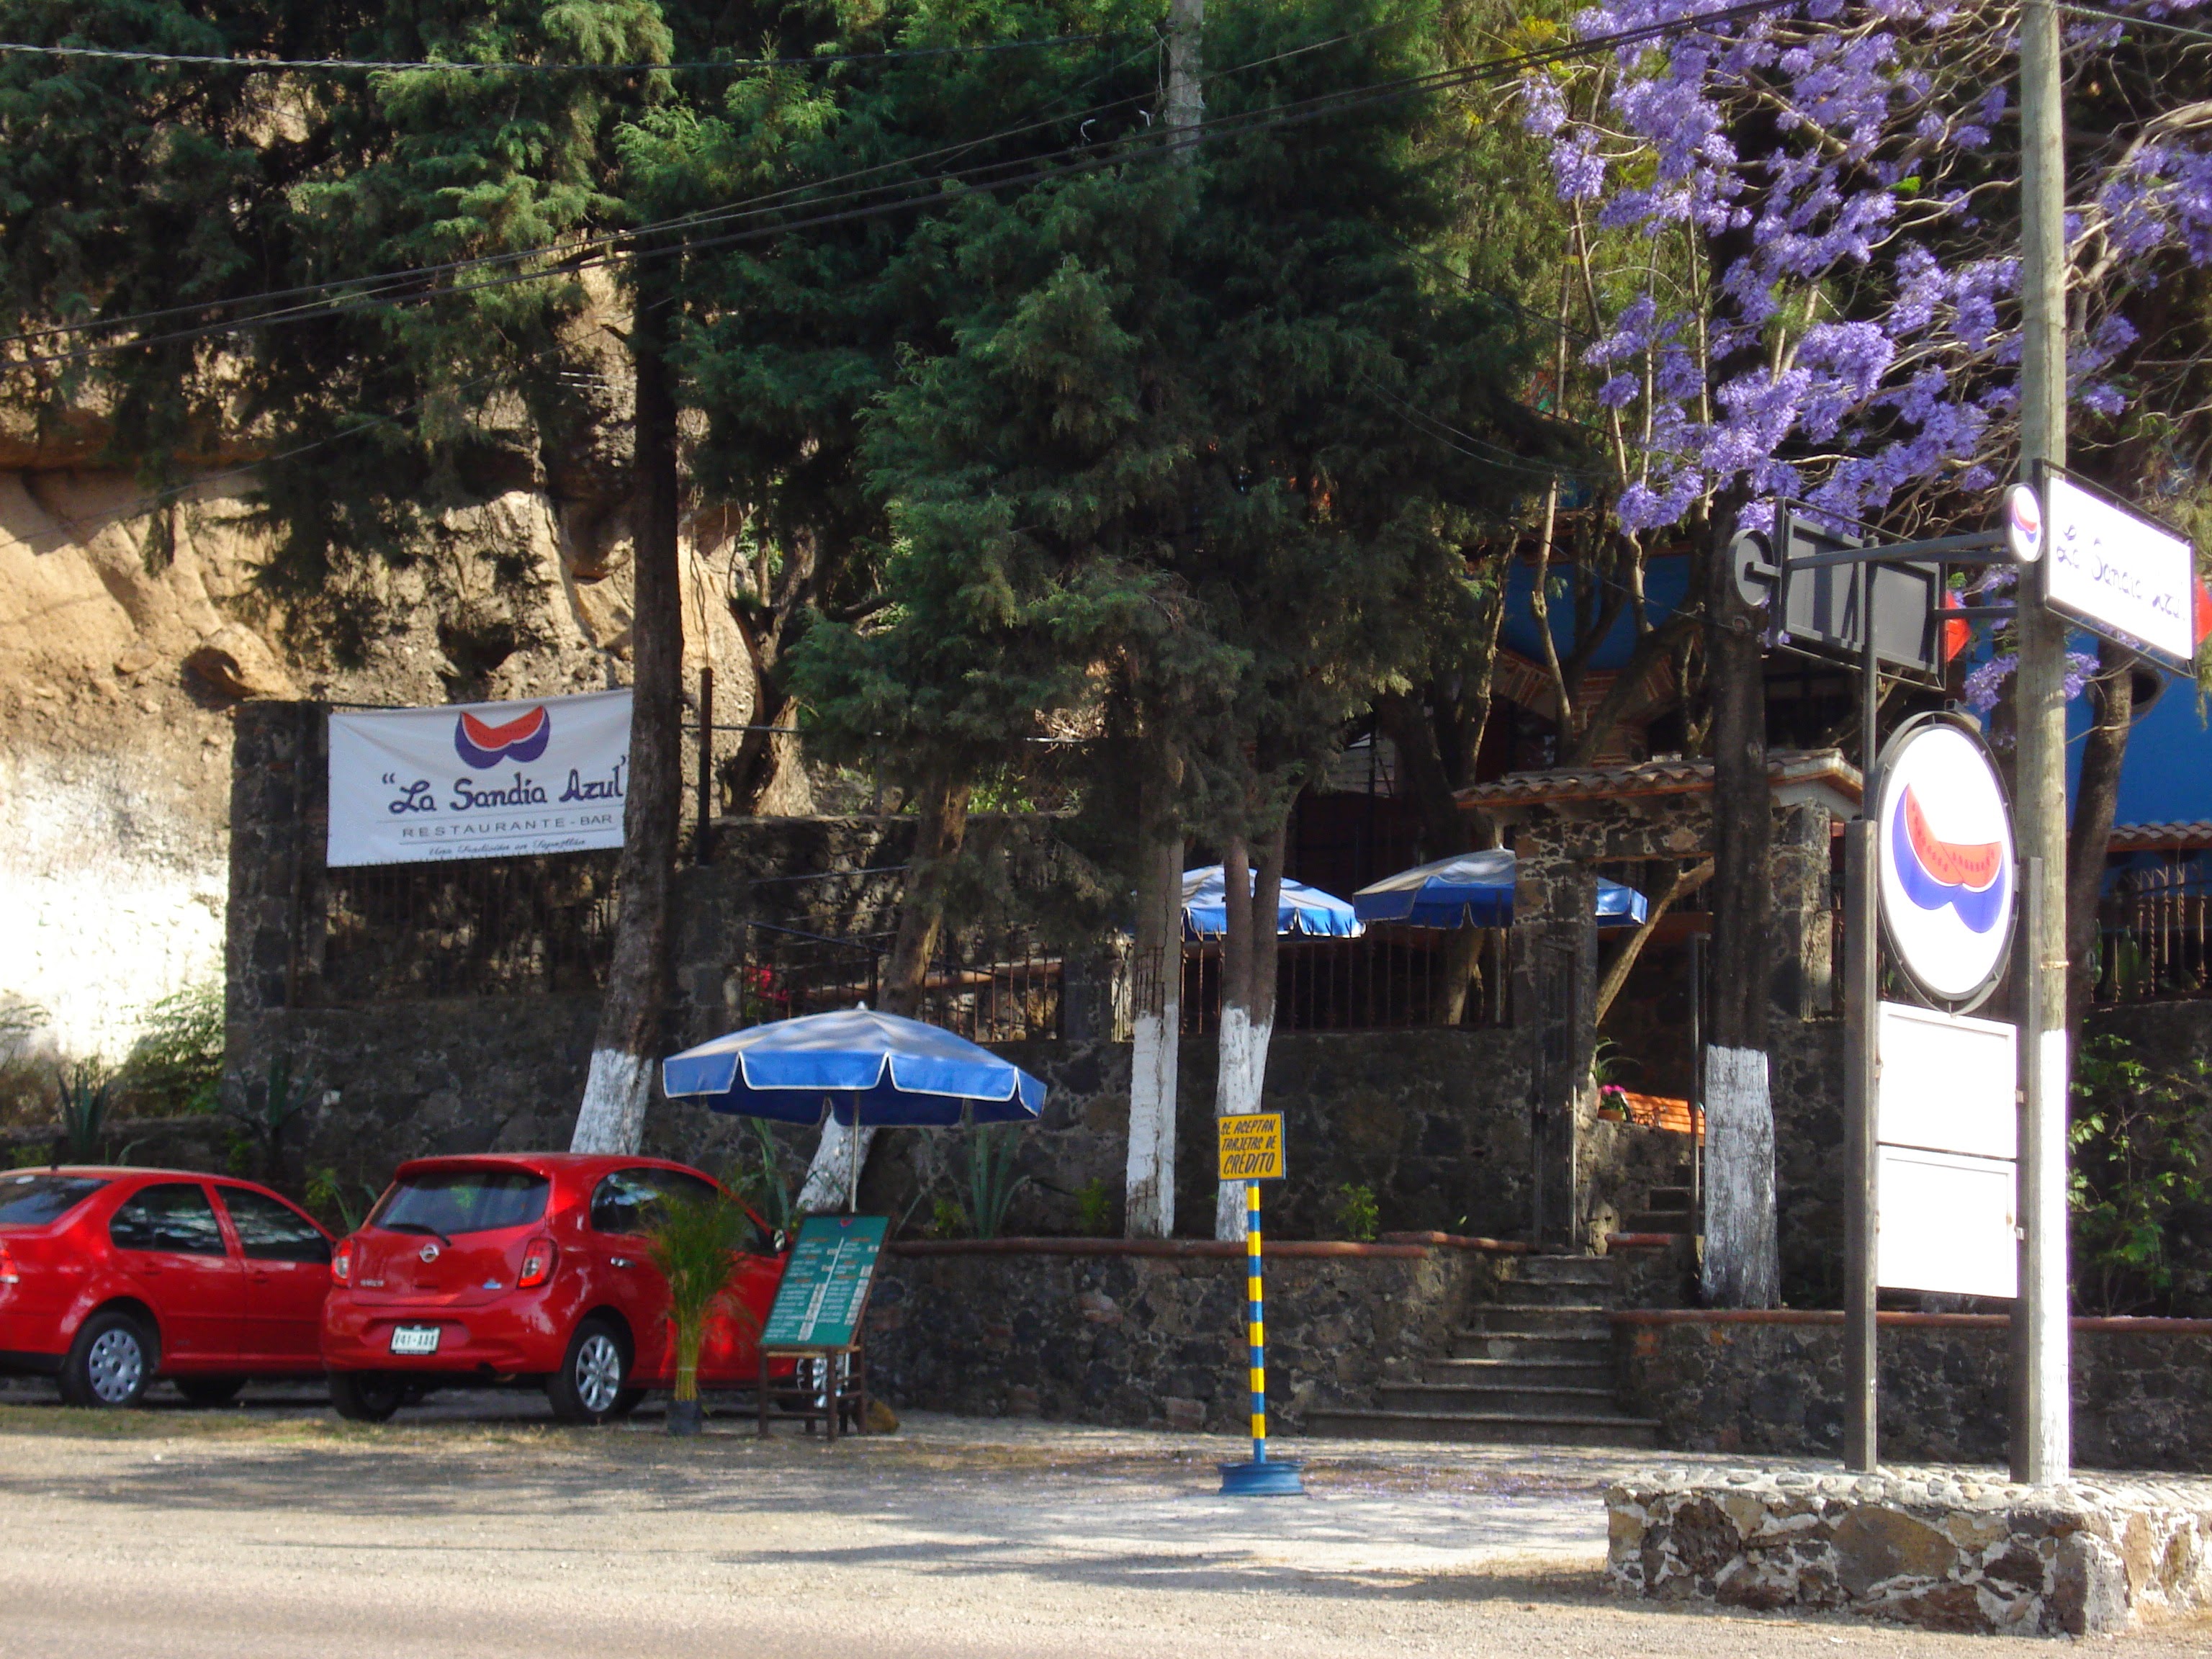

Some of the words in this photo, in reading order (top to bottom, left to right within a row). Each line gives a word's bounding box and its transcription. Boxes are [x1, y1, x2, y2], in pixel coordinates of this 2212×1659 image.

[1220, 1121, 1232, 1135] SE
[1233, 1119, 1276, 1135] ACEPTAN
[1222, 1136, 1264, 1152] TARJETAS
[1265, 1136, 1277, 1150] DE
